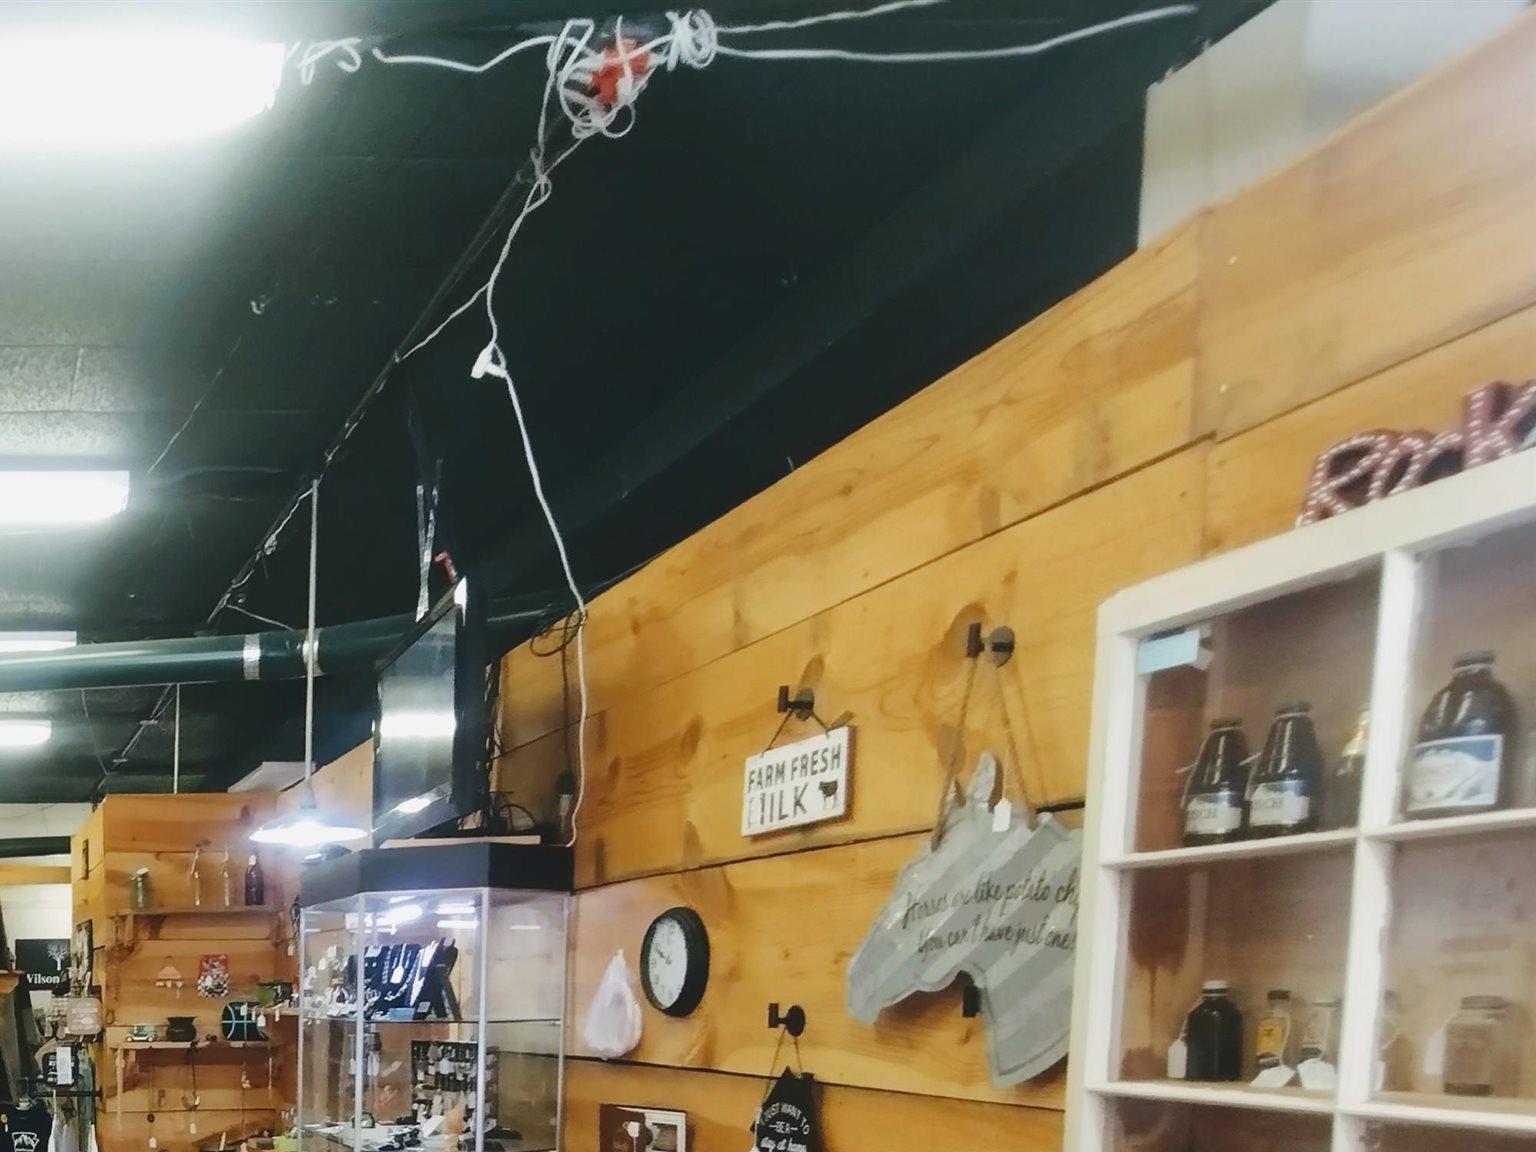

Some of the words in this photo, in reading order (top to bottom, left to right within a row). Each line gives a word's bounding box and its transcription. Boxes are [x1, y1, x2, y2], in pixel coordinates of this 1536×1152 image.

[747, 760, 786, 793] FARM
[790, 743, 842, 781] FRESH
[973, 871, 1002, 901] like
[1002, 866, 1052, 918] potato
[1012, 912, 1049, 955] just
